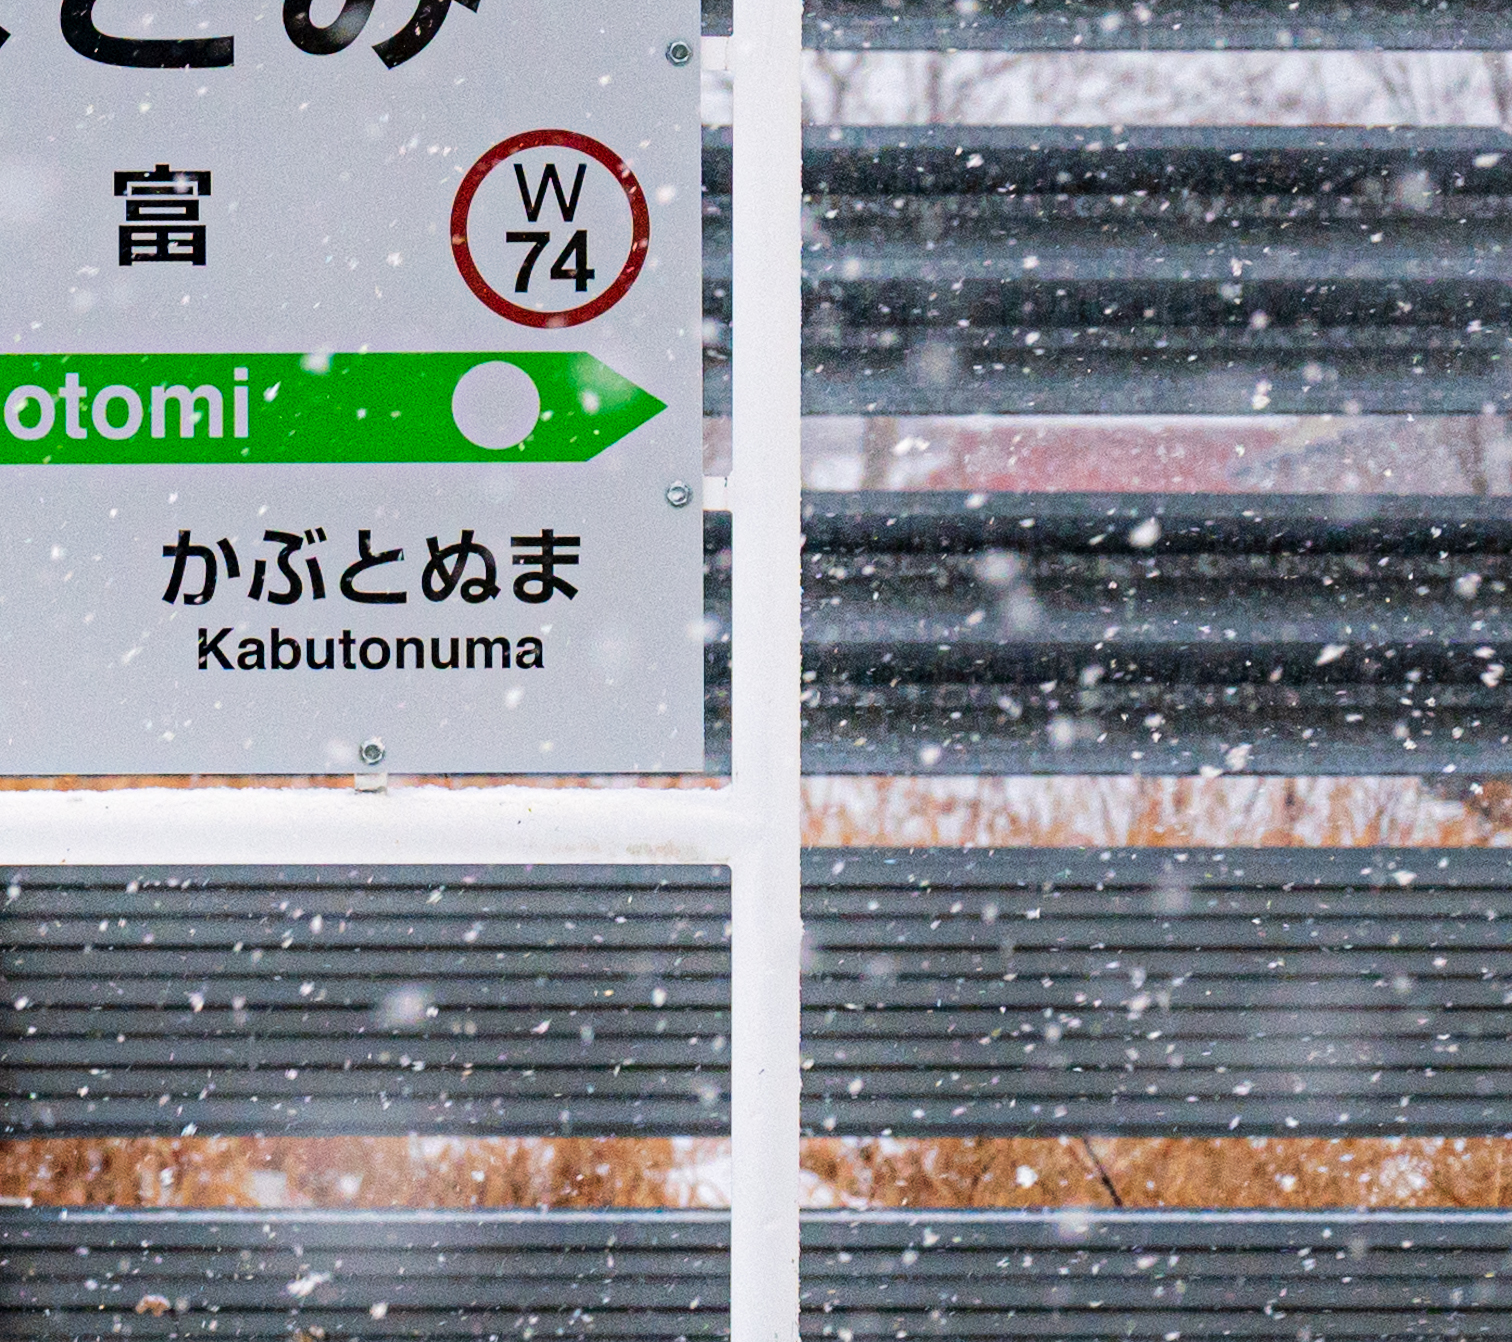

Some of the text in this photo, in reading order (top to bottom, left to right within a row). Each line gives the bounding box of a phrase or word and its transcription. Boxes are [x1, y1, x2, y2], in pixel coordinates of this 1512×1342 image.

[512, 163, 586, 223] W
[504, 229, 596, 295] 74
[162, 526, 581, 606] かぶとぬま
[197, 627, 545, 672] Kabutonuma
